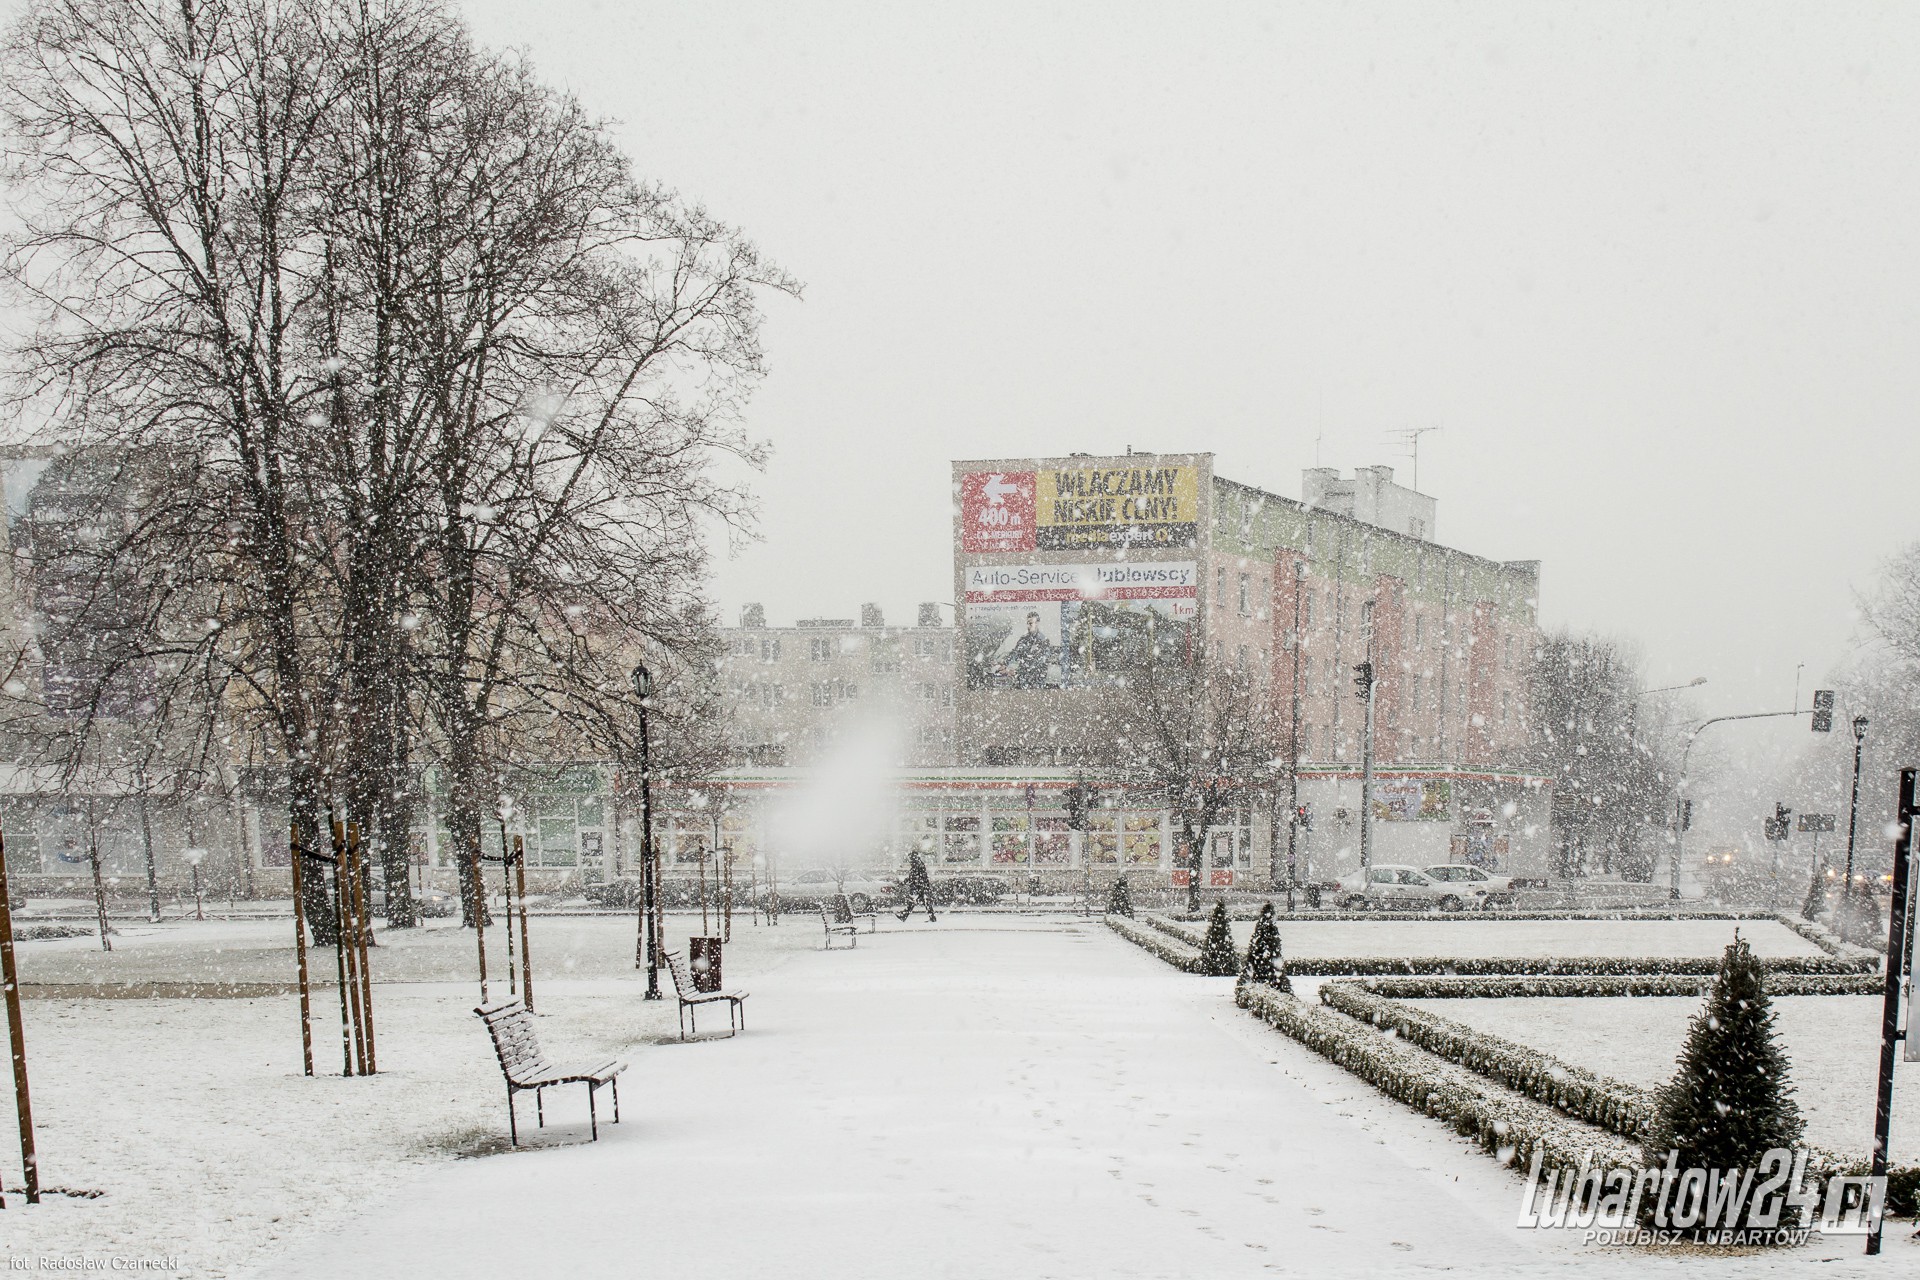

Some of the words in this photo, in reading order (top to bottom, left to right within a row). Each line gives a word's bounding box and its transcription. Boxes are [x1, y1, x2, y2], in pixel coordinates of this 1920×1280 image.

[979, 507, 1008, 526] 400
[1054, 498, 1117, 522] NISKIE
[972, 569, 1081, 585] Auto-Service
